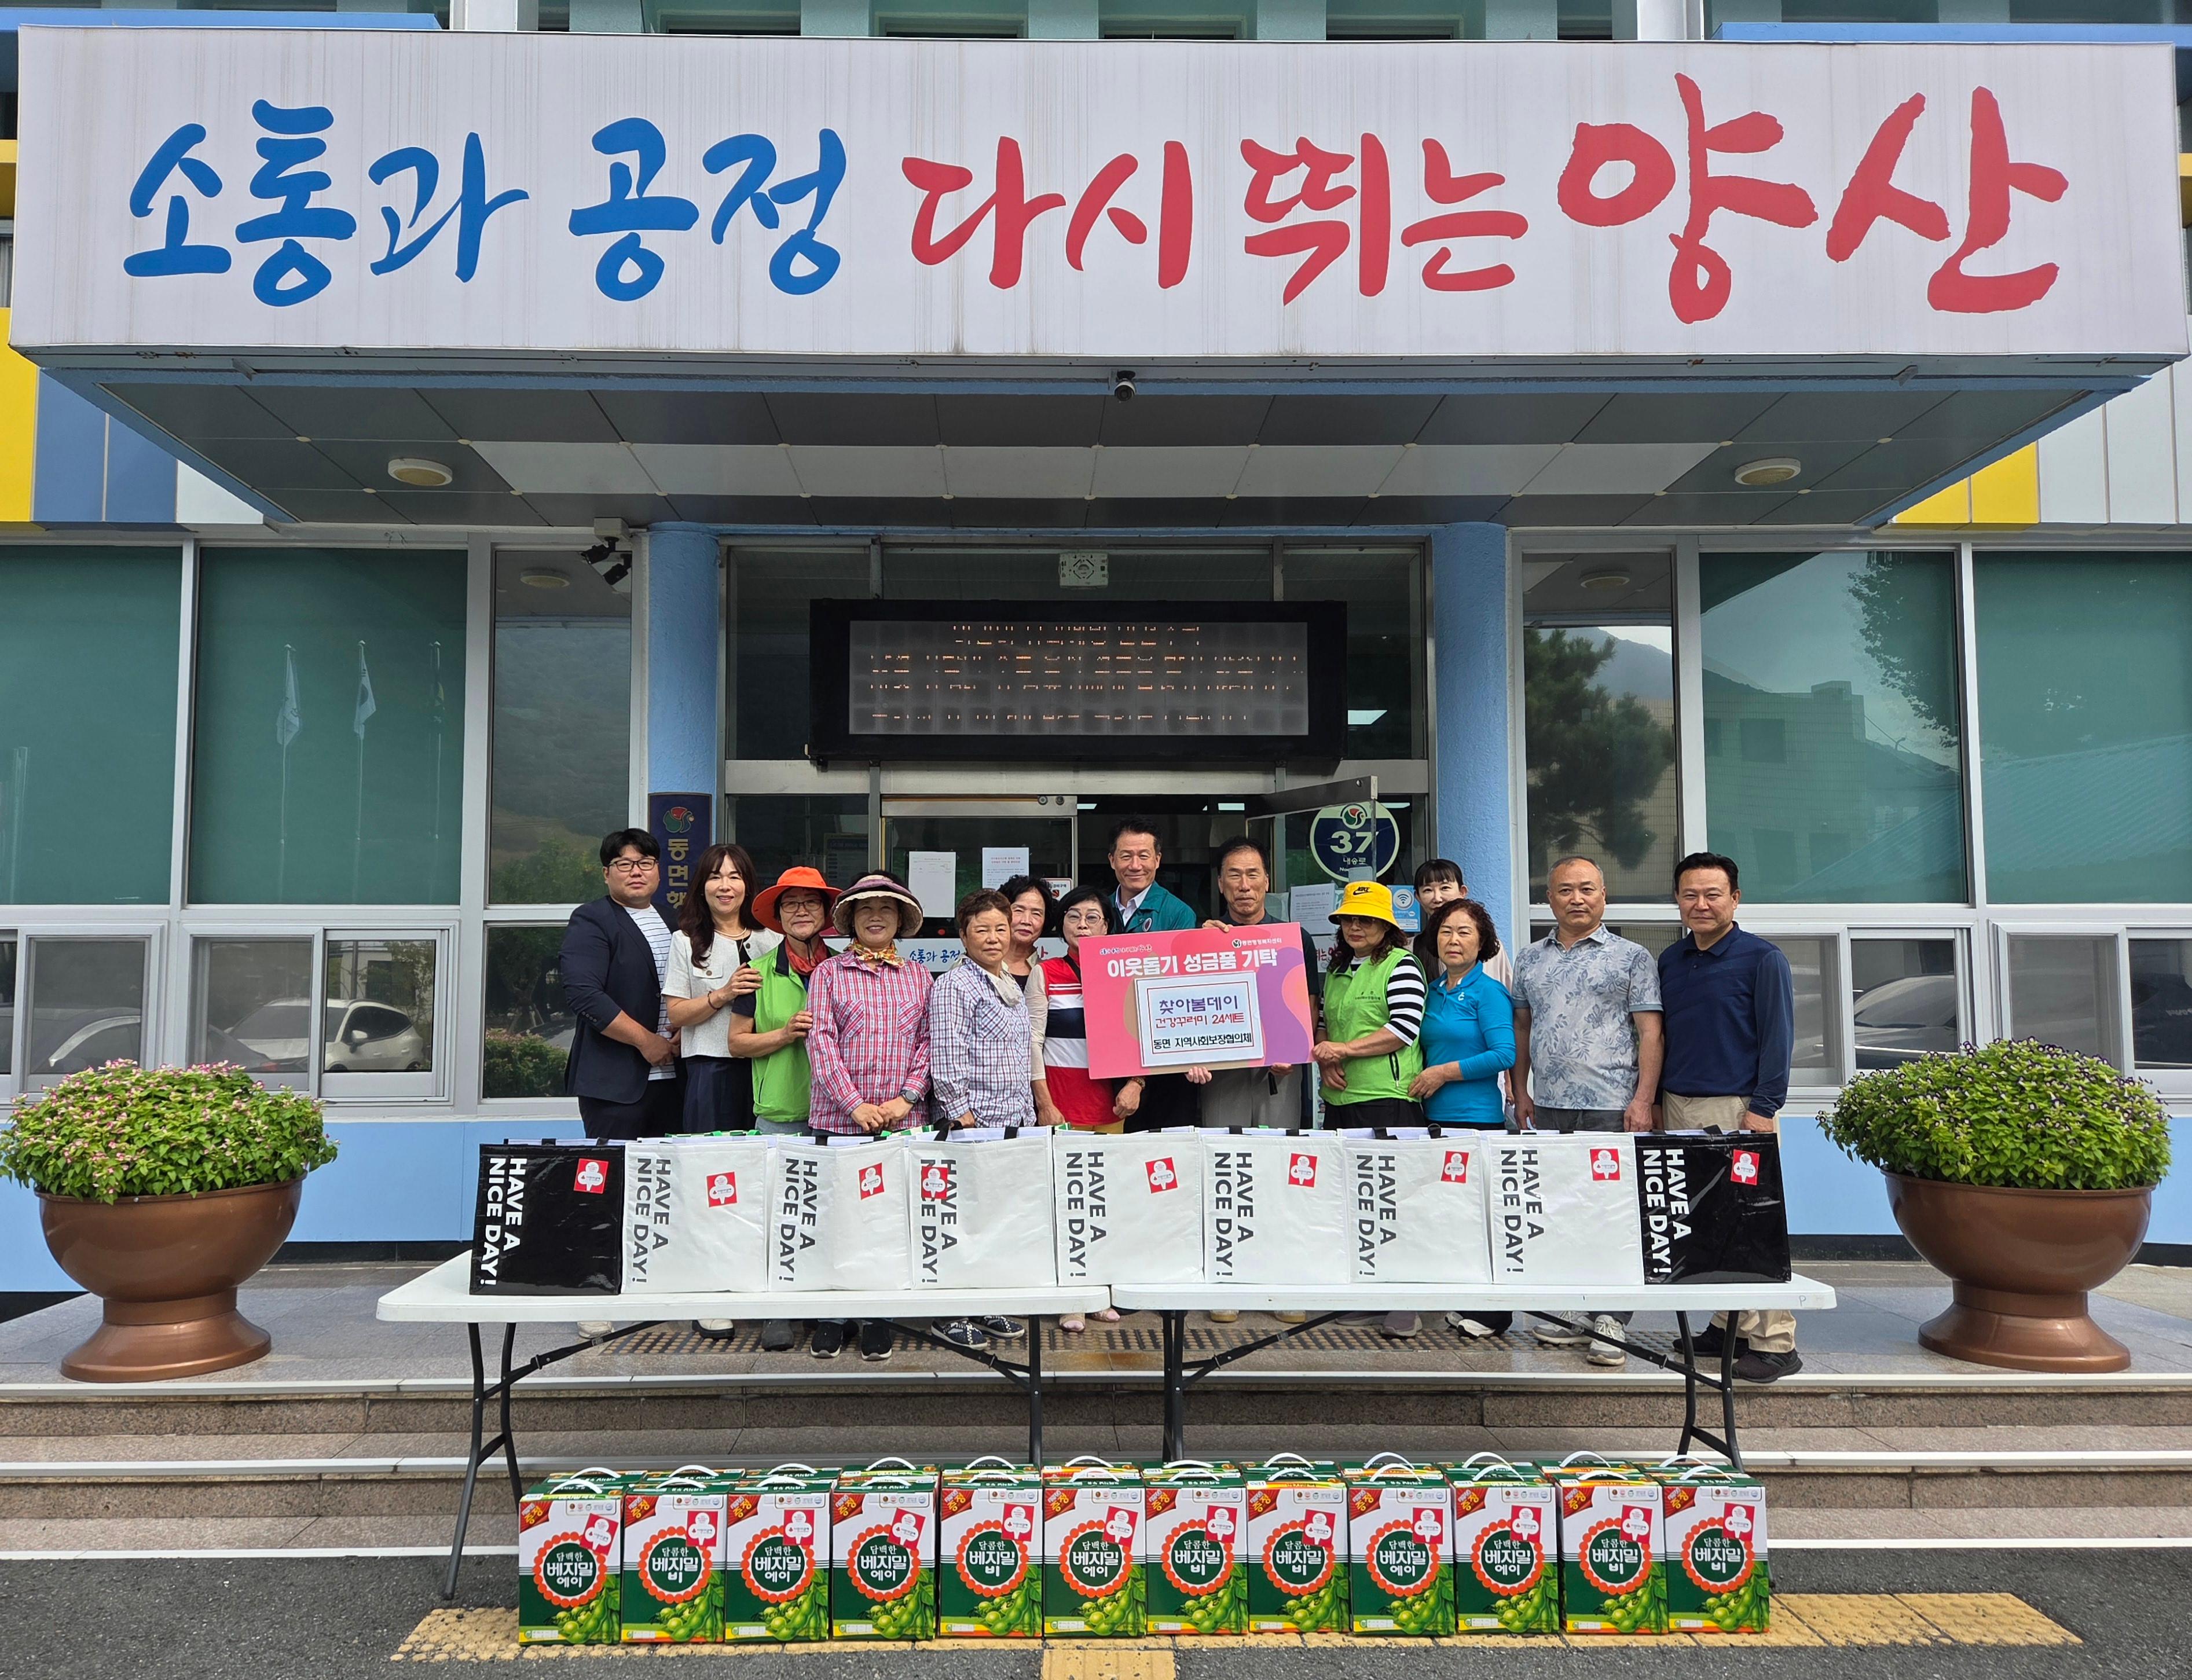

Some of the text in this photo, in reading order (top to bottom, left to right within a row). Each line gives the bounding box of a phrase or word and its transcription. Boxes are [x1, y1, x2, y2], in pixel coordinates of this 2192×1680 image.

[124, 74, 2068, 324] 소통과 공정 다시 뛰는 양산
[1330, 831, 1379, 854] 37
[910, 949, 938, 964] 소통과
[1107, 948, 1277, 978] 이웃돕기 성금품 기탁
[1159, 995, 1238, 1015] 찾아봄데이
[1156, 1013, 1244, 1029] 건강꾸러미 24세트
[1153, 1033, 1252, 1050] 동면 지역사회보장협의체
[1087, 1151, 1106, 1242] HAVE A
[1236, 1153, 1253, 1243] HAVE A
[1378, 1156, 1396, 1245] HAVE A
[1522, 1150, 1544, 1239] HAVE A
[1665, 1149, 1692, 1240] HAVE A
[503, 1158, 527, 1251] HAVE A
[652, 1159, 671, 1250] HAVE A
[799, 1160, 818, 1250] HAVE A
[940, 1158, 958, 1250] HAVE A
[1501, 1150, 1524, 1272] NICE DAY!
[1643, 1150, 1672, 1273] NICE DAY!
[480, 1158, 507, 1285] NICE DAY!
[633, 1158, 652, 1282] NICE DAY!
[780, 1158, 800, 1282] NICE DAY!
[1066, 1153, 1086, 1276] NICE DAY!
[1215, 1153, 1233, 1276] NICE DAY!
[1356, 1154, 1375, 1276] NICE DAY!
[921, 1225, 937, 1283] DAY!
[978, 1540, 1006, 1551] 달콤한
[1082, 1540, 1109, 1551] 담백한
[1183, 1539, 1210, 1550] 달콤한
[1388, 1540, 1416, 1550] 담백한
[1494, 1539, 1520, 1549] 담백한
[1601, 1538, 1628, 1548] 달콤한
[1703, 1537, 1731, 1547] 달콤한
[556, 1551, 583, 1562] 담백한
[662, 1546, 689, 1557] 달콤한
[765, 1546, 792, 1556] 담백한
[870, 1545, 897, 1555] 담백한
[1174, 1550, 1220, 1564] 베지밀
[1275, 1550, 1321, 1564] 베지밀
[1379, 1550, 1426, 1565] 베지밀
[1484, 1550, 1531, 1564] 베지밀
[1592, 1549, 1638, 1563] 베지밀
[1694, 1547, 1741, 1562] 베지밀
[652, 1557, 698, 1572] 베지밀
[754, 1556, 801, 1571] 베지밀
[860, 1555, 907, 1570] 베지밀
[969, 1551, 1015, 1565] 베지밀
[1072, 1551, 1119, 1566] 베지밀
[547, 1562, 593, 1576] 베지밀
[985, 1565, 1000, 1577] 비
[1082, 1565, 1108, 1578] 에이
[1190, 1564, 1205, 1576] 비
[1292, 1564, 1307, 1576] 비
[1390, 1565, 1416, 1577] 에이
[1494, 1564, 1520, 1576] 에이
[1608, 1562, 1624, 1575] 비
[1711, 1562, 1726, 1573] 비
[556, 1576, 582, 1588] 에이
[668, 1571, 683, 1583] 비
[764, 1571, 790, 1583] 에이
[870, 1569, 896, 1582] 에이
